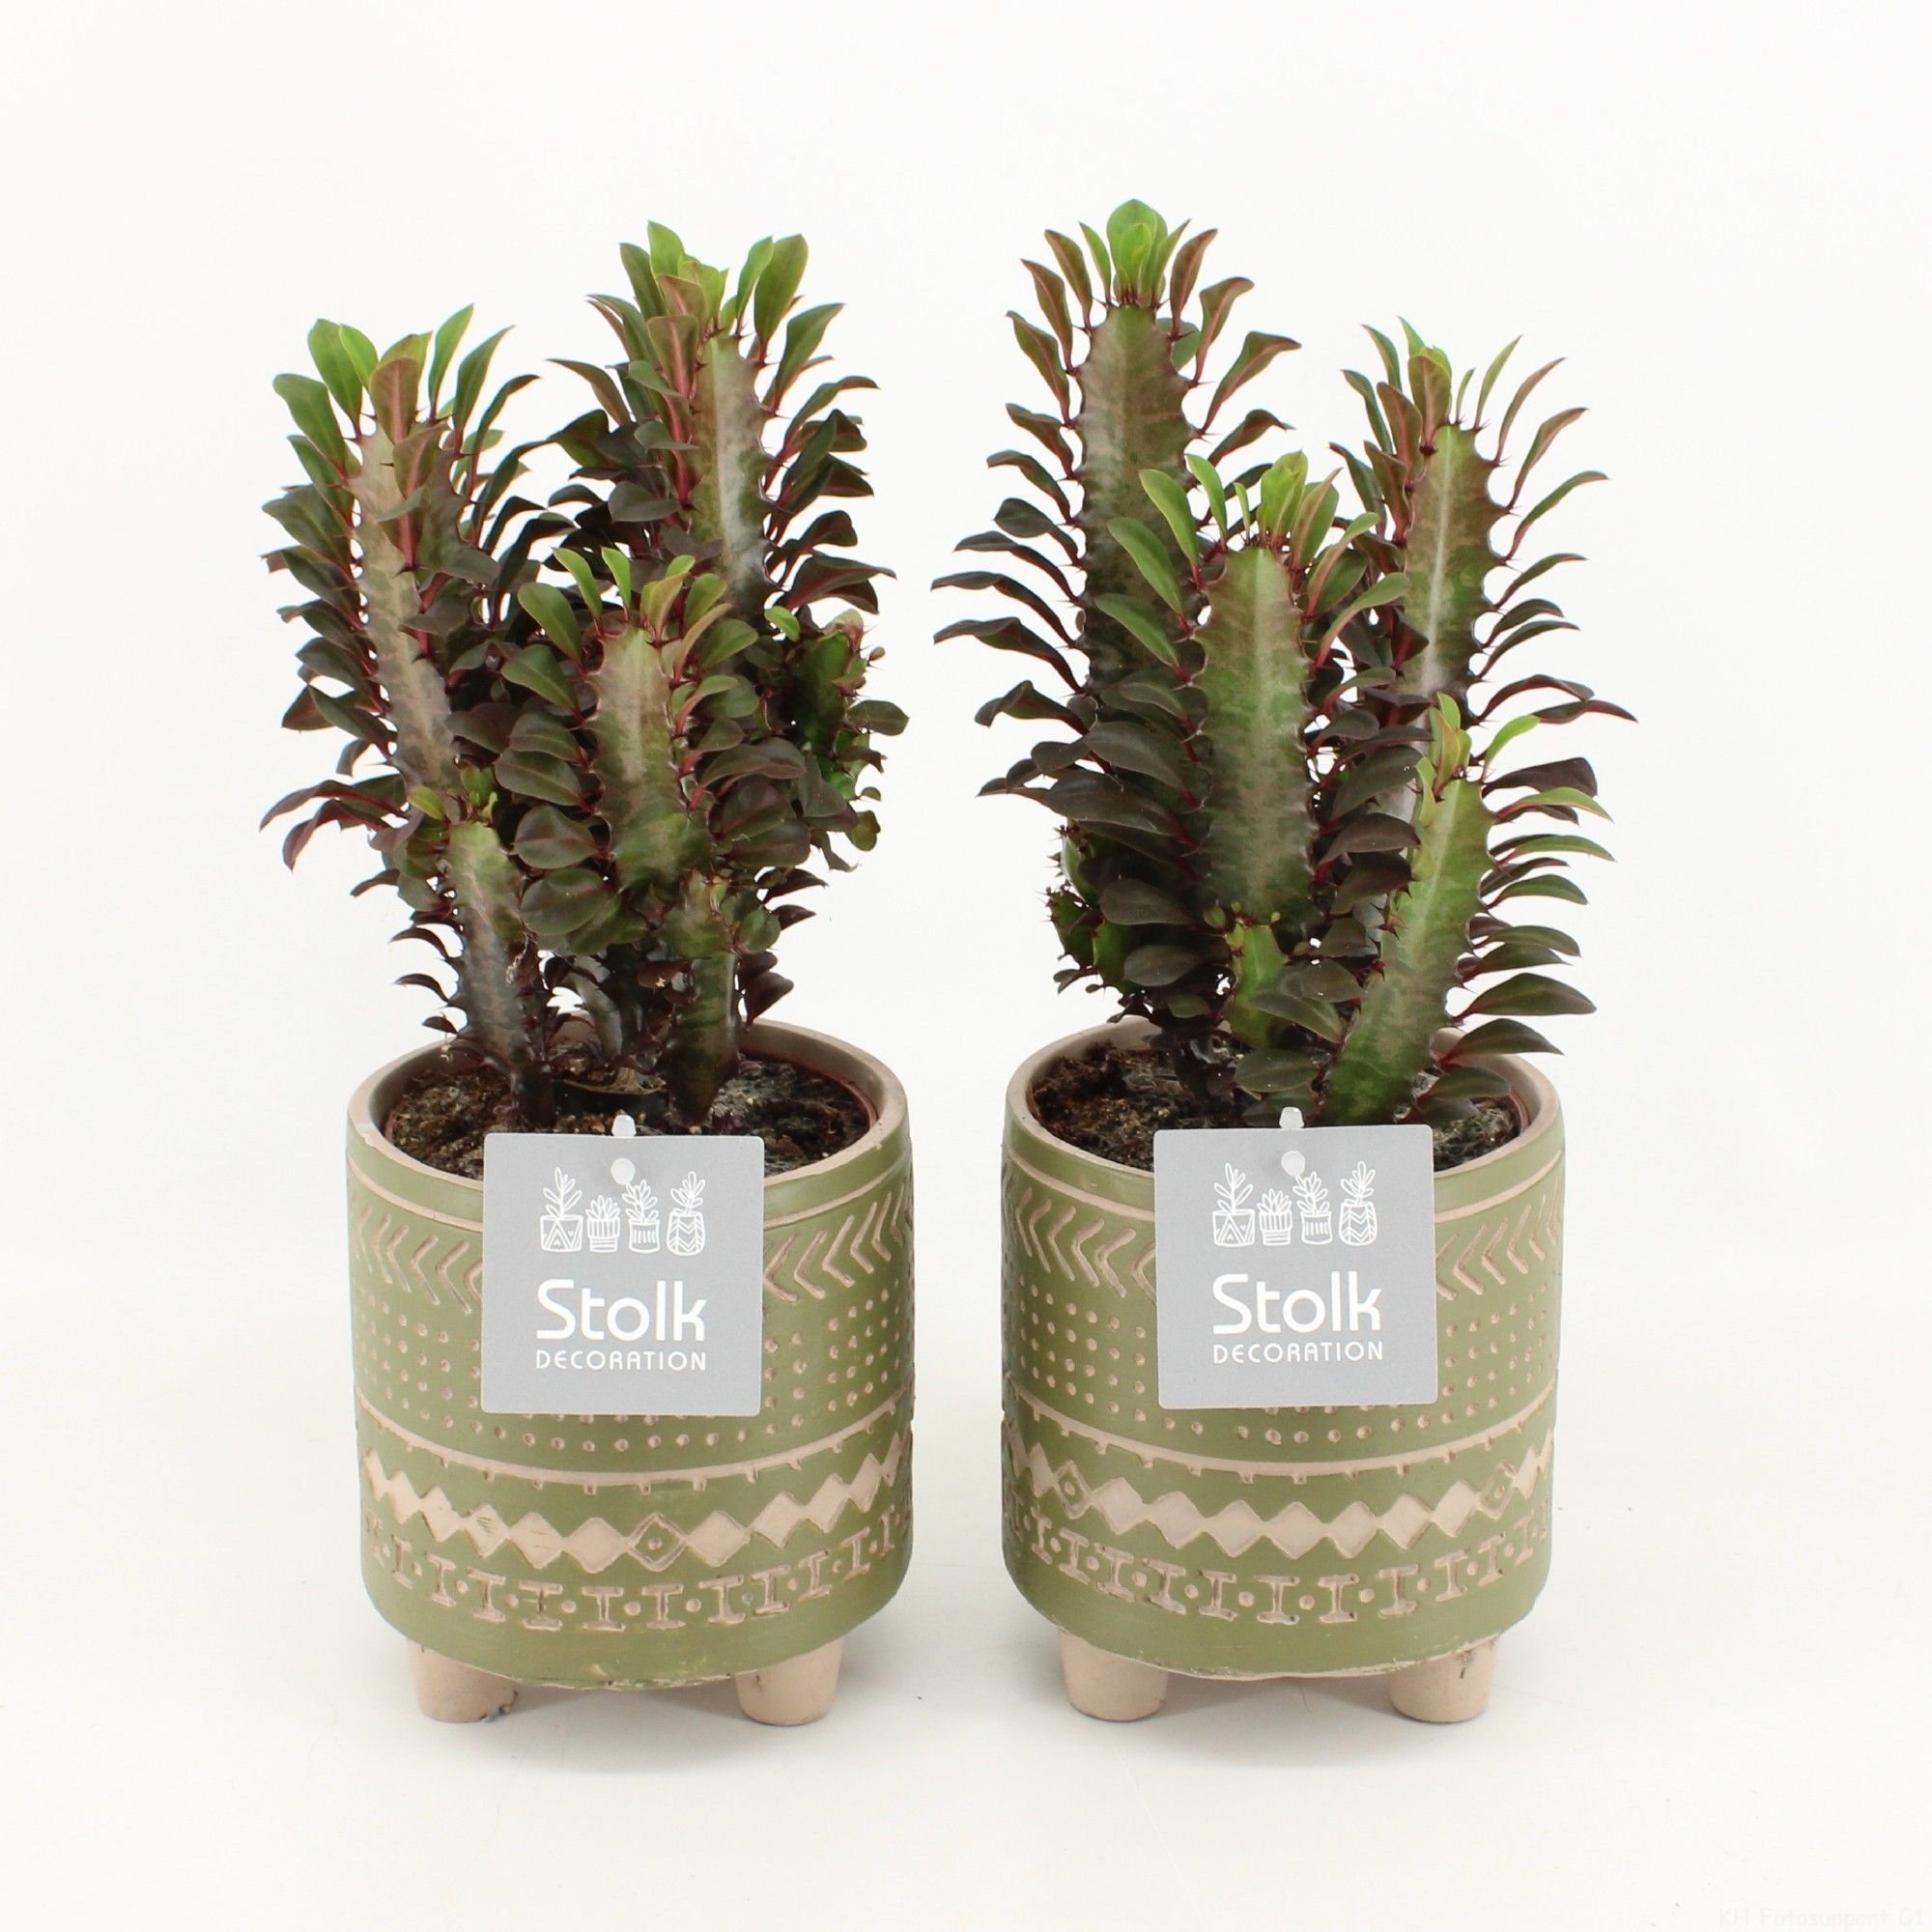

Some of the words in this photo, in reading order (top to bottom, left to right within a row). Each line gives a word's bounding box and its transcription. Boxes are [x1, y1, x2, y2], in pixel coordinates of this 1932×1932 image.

[536, 1278, 707, 1342] Stolk
[1212, 1270, 1381, 1334] Stolk
[536, 1349, 707, 1372] DECORATION
[1213, 1341, 1383, 1364] DECORATION
